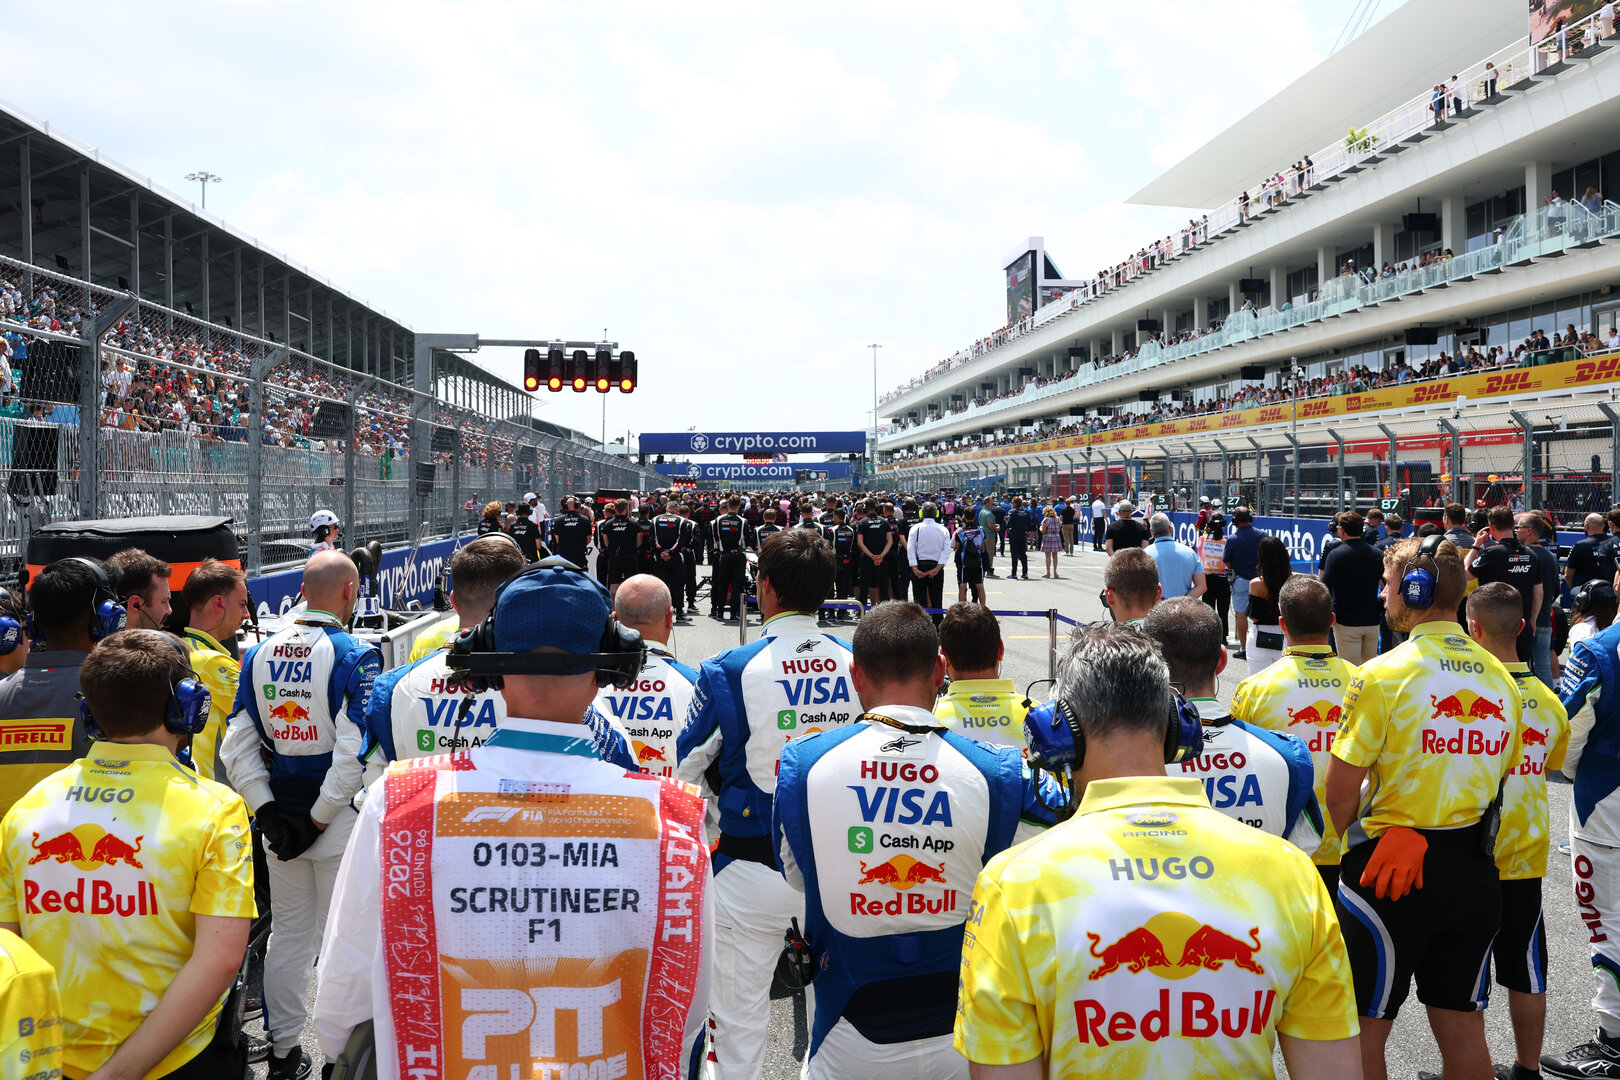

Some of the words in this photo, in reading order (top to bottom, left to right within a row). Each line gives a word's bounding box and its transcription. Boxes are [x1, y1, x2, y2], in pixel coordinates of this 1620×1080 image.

[1485, 371, 1533, 393] DHL
[1413, 382, 1452, 403] DHL
[1259, 408, 1284, 422] DHL
[1303, 401, 1329, 416] DHL
[714, 434, 817, 451] crypto.com
[706, 464, 792, 479] crypto.com
[1158, 495, 1165, 503] 5
[1227, 497, 1240, 505] 27
[1381, 499, 1399, 510] 87
[273, 645, 312, 658] HUGO
[266, 660, 312, 683] VISA
[782, 658, 837, 675] HUGO
[1440, 658, 1485, 674] HUGO
[775, 676, 850, 706] VISA
[1298, 678, 1342, 688] HUGO
[279, 688, 300, 698] Cash
[419, 697, 497, 728] VISA
[603, 696, 674, 721] VISA
[800, 713, 827, 724] Cash
[828, 711, 850, 725] App
[963, 715, 1011, 728] HUGO
[291, 725, 318, 741] Bull
[651, 728, 673, 739] App
[1422, 728, 1463, 754] Red
[861, 760, 939, 783] HUGO
[65, 786, 135, 803] HUGO
[1201, 774, 1264, 808] ISA
[522, 810, 544, 821] FIA
[846, 785, 953, 827] VISA
[548, 816, 573, 824] World
[573, 816, 633, 825] Championship
[1133, 811, 1171, 826] Ford
[879, 833, 919, 849] Cash
[922, 835, 955, 852] App
[1122, 829, 1188, 838] RACING
[473, 841, 619, 868] 0103-MIA
[389, 830, 412, 899] 2026
[1108, 855, 1215, 881] HUGO
[413, 854, 427, 898] ROUND
[662, 818, 700, 943] MIAMI
[24, 878, 85, 915] Red
[91, 880, 159, 917] Bull
[449, 887, 640, 914] SCRUTINEER
[850, 892, 902, 916] Red
[907, 889, 957, 914] Bull
[1574, 854, 1607, 943] HUGO
[527, 918, 562, 943] F1
[1073, 988, 1170, 1048] Red
[1181, 989, 1277, 1039] Bull
